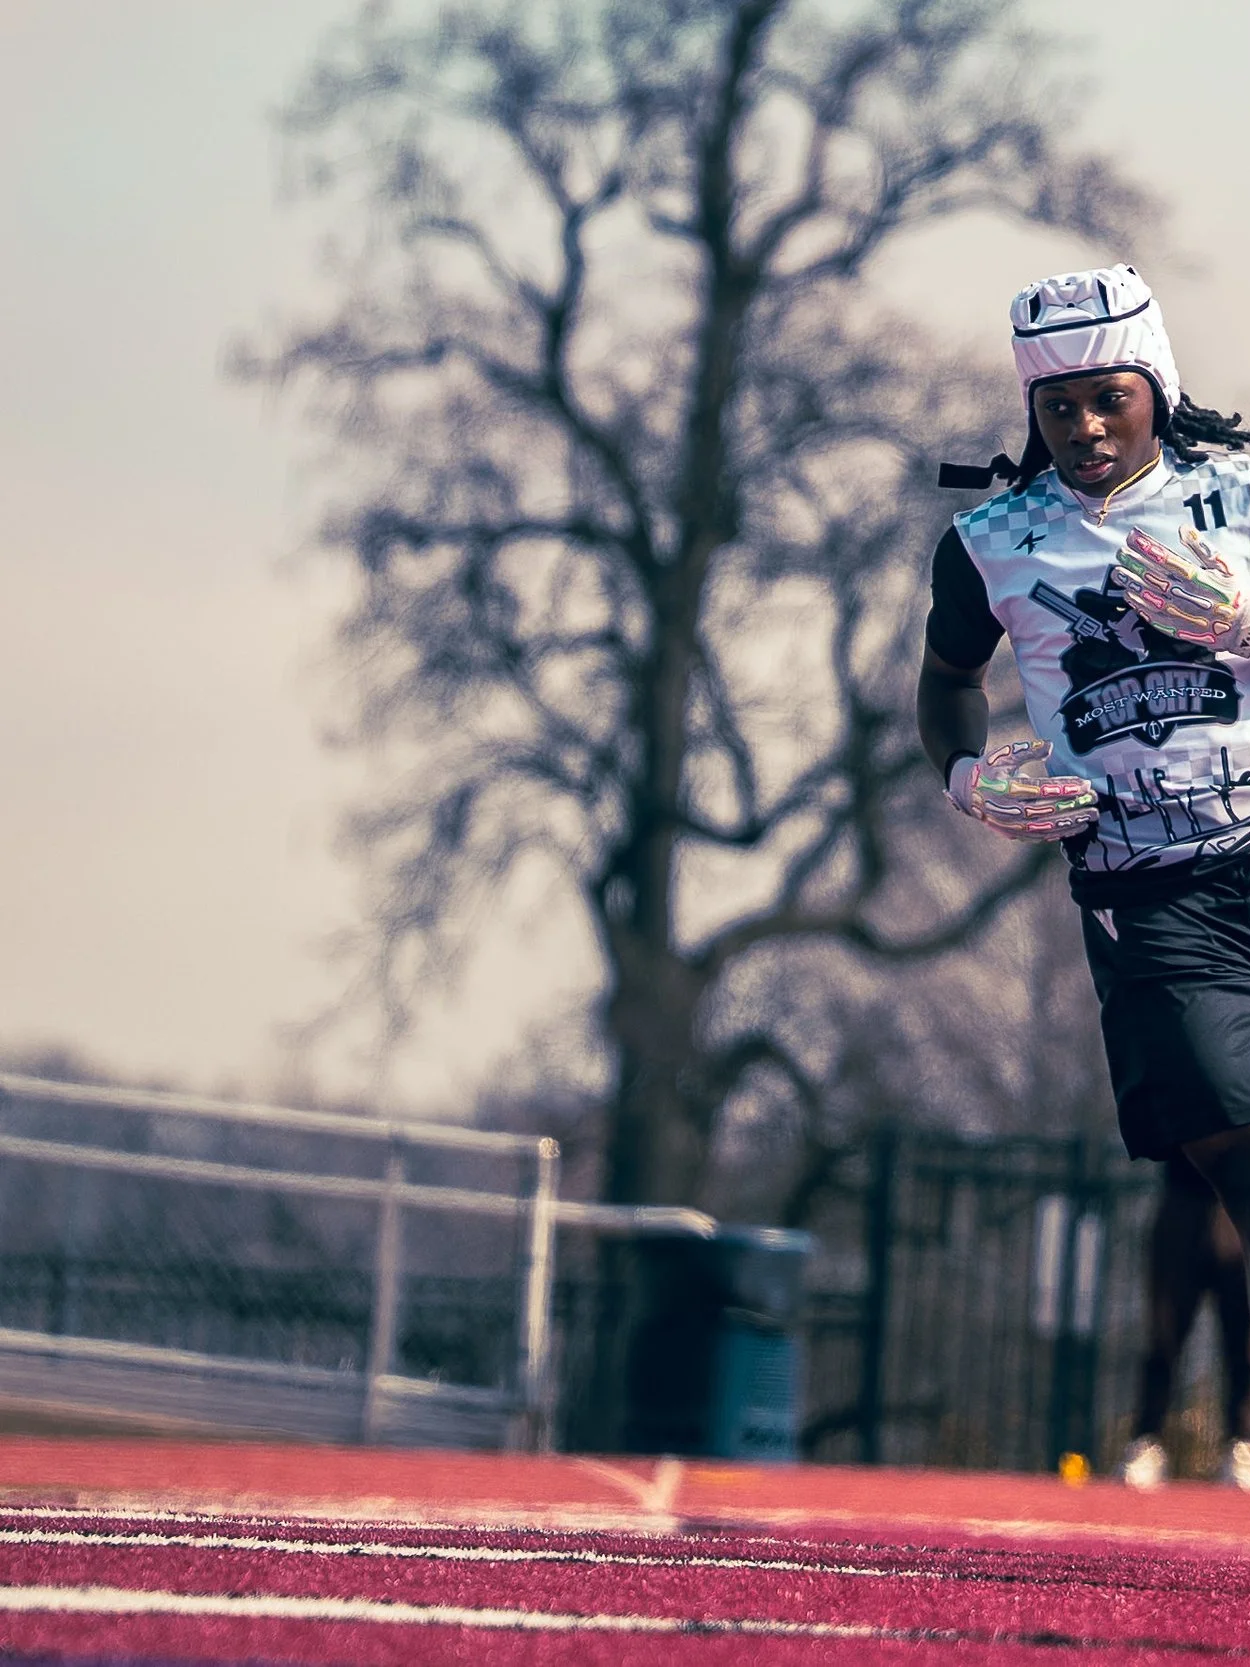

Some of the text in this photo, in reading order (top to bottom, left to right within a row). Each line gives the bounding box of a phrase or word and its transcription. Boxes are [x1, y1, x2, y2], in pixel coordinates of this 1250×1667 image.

[1183, 489, 1227, 531] 11
[1075, 686, 1227, 727] MOST WANTED
[1085, 670, 1209, 731] TOP CITY
